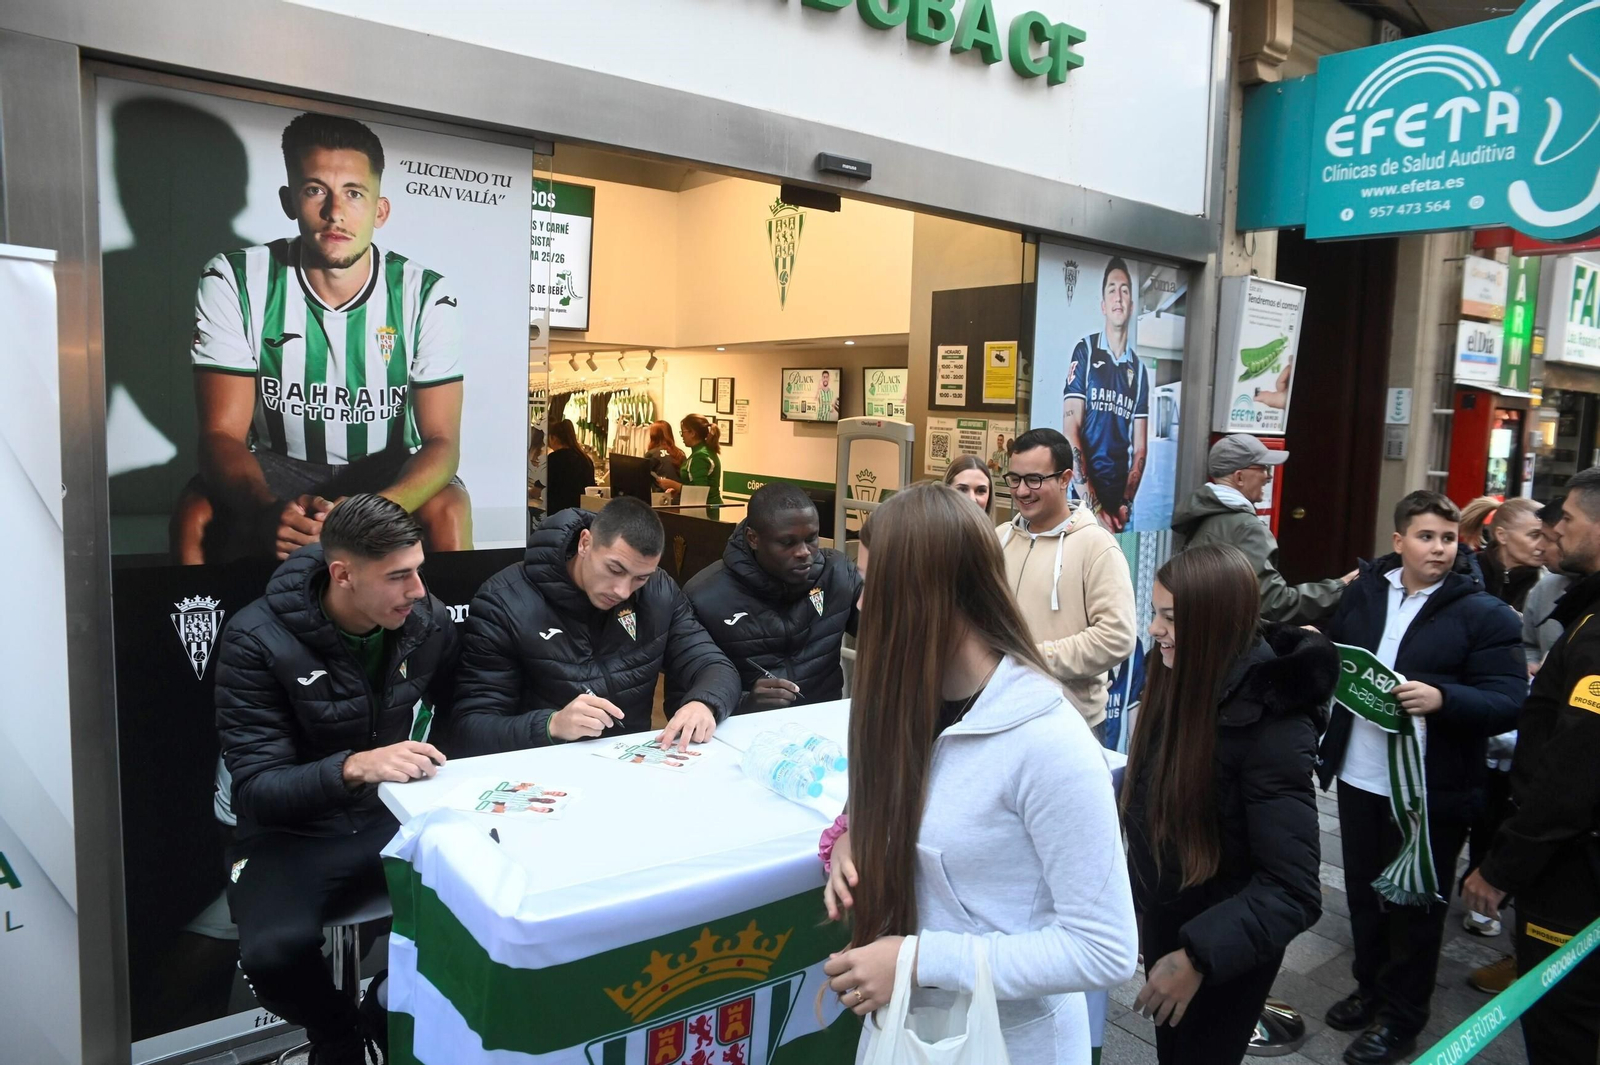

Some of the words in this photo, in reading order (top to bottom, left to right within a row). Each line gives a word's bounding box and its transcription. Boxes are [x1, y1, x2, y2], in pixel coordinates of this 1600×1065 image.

[1008, 11, 1087, 87] CF
[1325, 90, 1520, 158] EFETA
[1322, 163, 1377, 183] Clínicas
[1380, 157, 1399, 177] de
[1402, 150, 1446, 173] Salud
[1448, 143, 1515, 168] Auditiva
[491, 173, 513, 188] TU
[1361, 177, 1465, 198] www.efeta.es
[405, 181, 452, 199] GRAN
[455, 187, 506, 206] VALÍA”
[1369, 204, 1395, 219] 957
[1396, 202, 1421, 215] 473
[1425, 200, 1451, 213] 564
[539, 221, 545, 232] Y
[546, 222, 569, 235] CARNÉ
[541, 251, 565, 264] 25/26
[537, 284, 546, 294] DE
[1569, 264, 1600, 330] FA
[1248, 293, 1275, 307] Tendremos
[1276, 298, 1282, 308] el
[1282, 302, 1300, 311] control
[261, 376, 408, 409] BAHRAIN
[1091, 387, 1134, 411] BAHRAIN
[263, 395, 406, 424] VICTORIOUS
[1091, 401, 1131, 420] VICTORIOUS
[1231, 409, 1255, 422] EFETA
[1541, 948, 1577, 988] CÓRDOBA
[1576, 933, 1593, 956] CLUB
[254, 1012, 285, 1028] tie
[1460, 1029, 1476, 1053] DE
[1472, 1005, 1507, 1042] FÚTBOL
